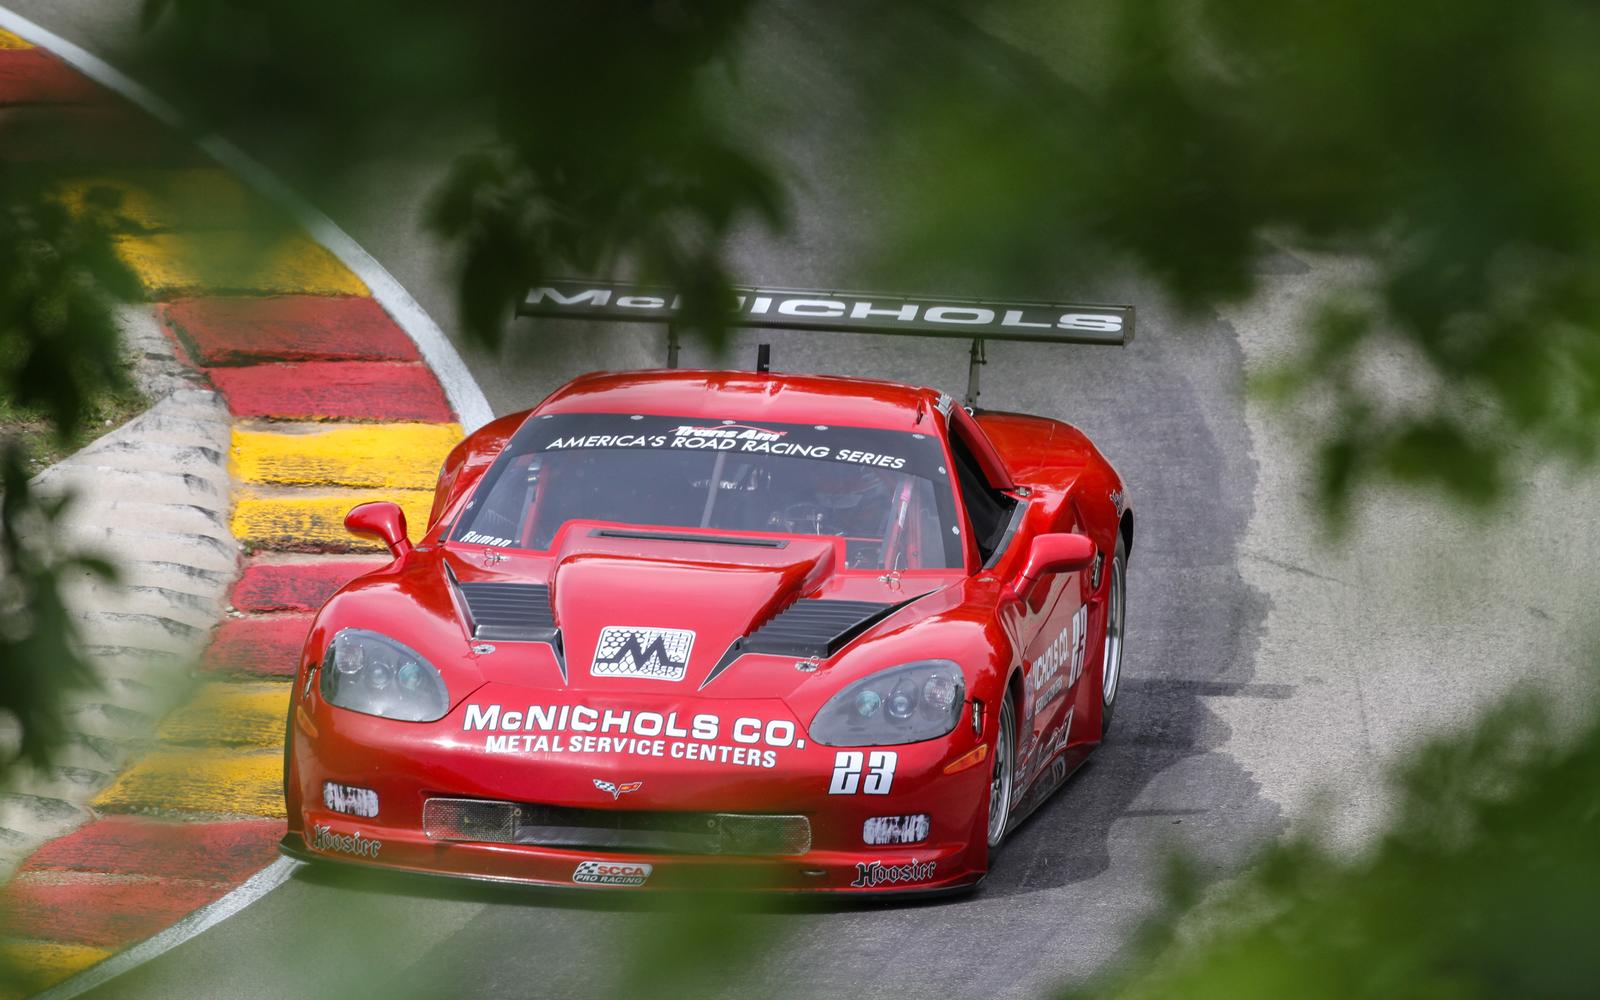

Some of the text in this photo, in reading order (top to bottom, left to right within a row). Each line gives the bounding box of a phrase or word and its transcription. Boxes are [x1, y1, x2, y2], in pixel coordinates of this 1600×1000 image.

[546, 435, 906, 469] AMERICA'S ROAD RACING SERIES
[460, 530, 512, 547] Ruman
[463, 704, 806, 750] McNICHOLS CO.
[485, 734, 777, 769] METAL SERVICE CENTERS
[828, 750, 898, 795] 23
[313, 823, 382, 858] Hoosier
[576, 874, 643, 884] PRO RACING
[597, 865, 646, 876] SCCA
[850, 858, 937, 887] Hoosier
